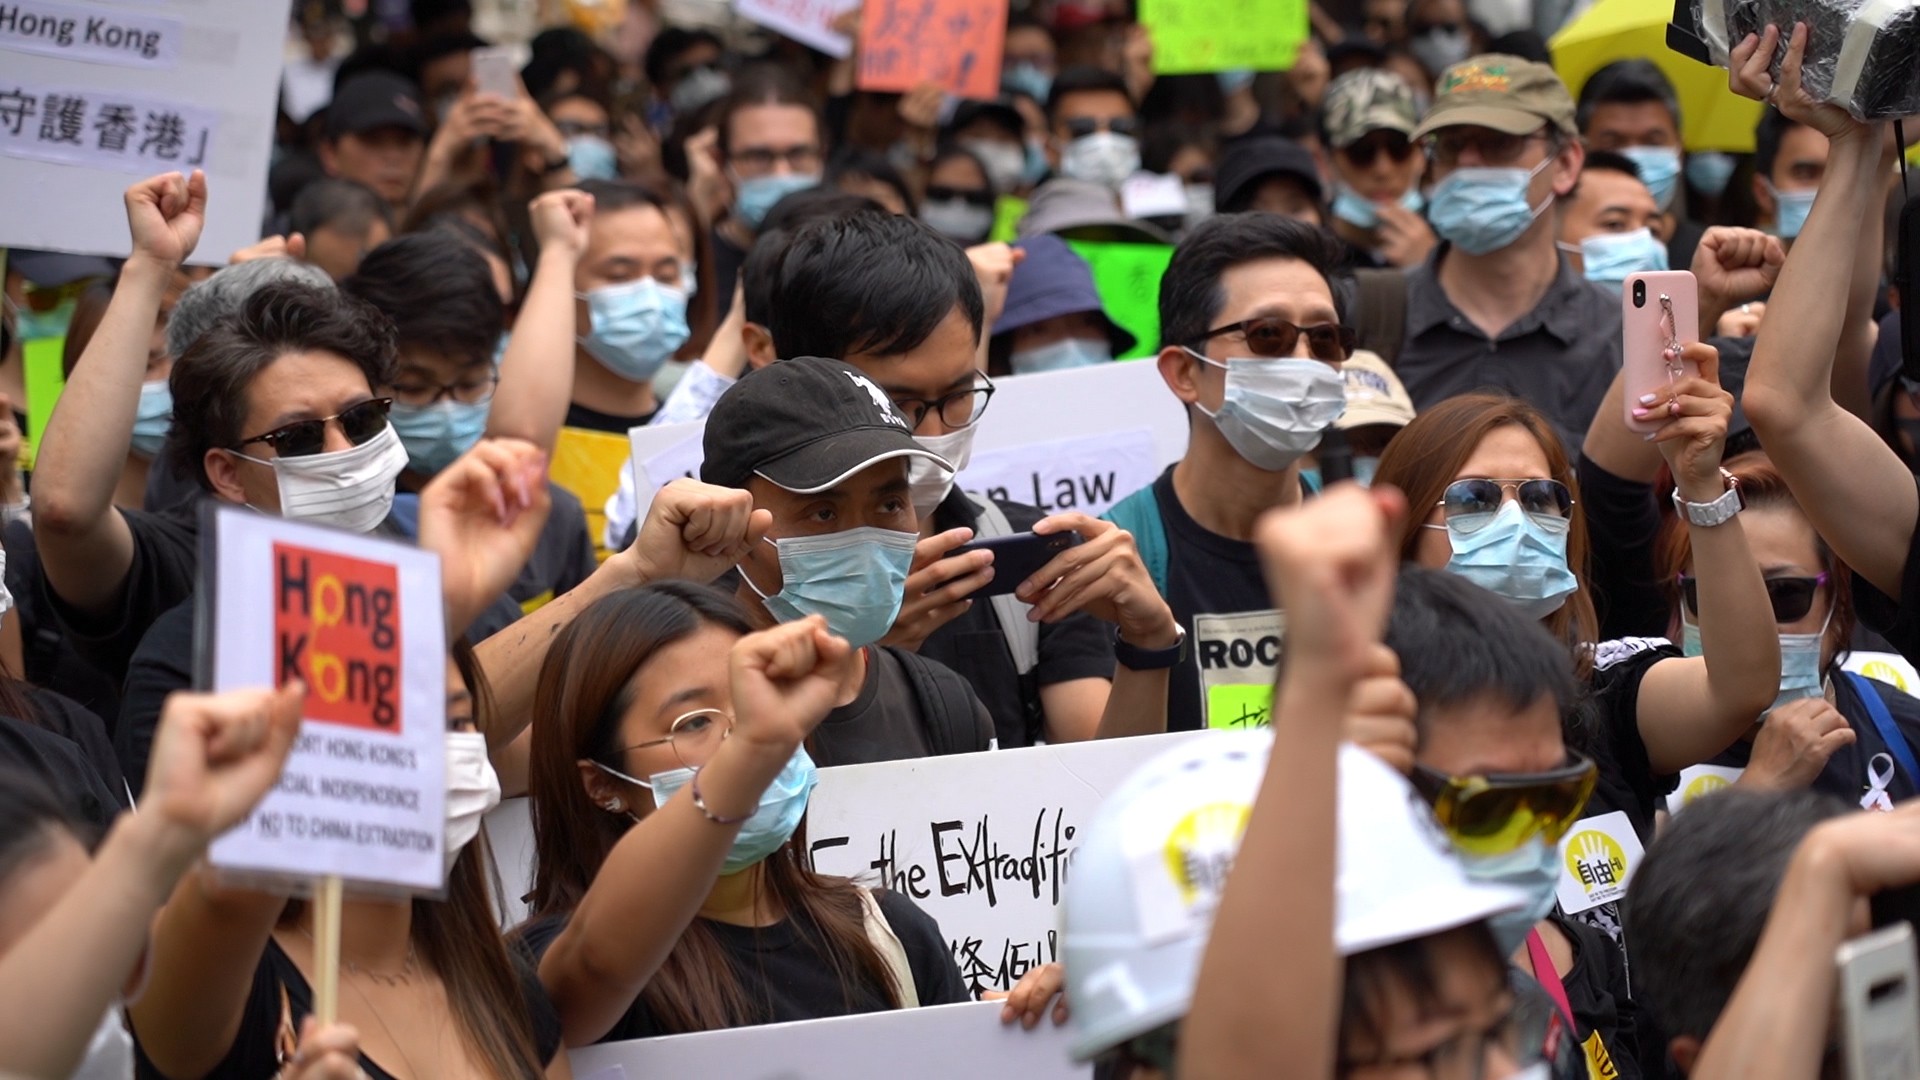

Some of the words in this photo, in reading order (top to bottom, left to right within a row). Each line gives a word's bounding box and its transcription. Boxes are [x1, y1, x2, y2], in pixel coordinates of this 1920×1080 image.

[0, 4, 76, 47] Hong
[84, 15, 163, 60] Kong
[1032, 470, 1117, 511] Law
[280, 554, 395, 650] Hong
[281, 632, 396, 728] Kong
[327, 738, 366, 764] HONG
[320, 776, 421, 812] INDEPENDENCE
[257, 811, 284, 837] NO
[287, 813, 309, 838] TO
[311, 816, 353, 842] CHINA
[356, 822, 436, 852] EXTRADITION
[871, 829, 931, 899] the
